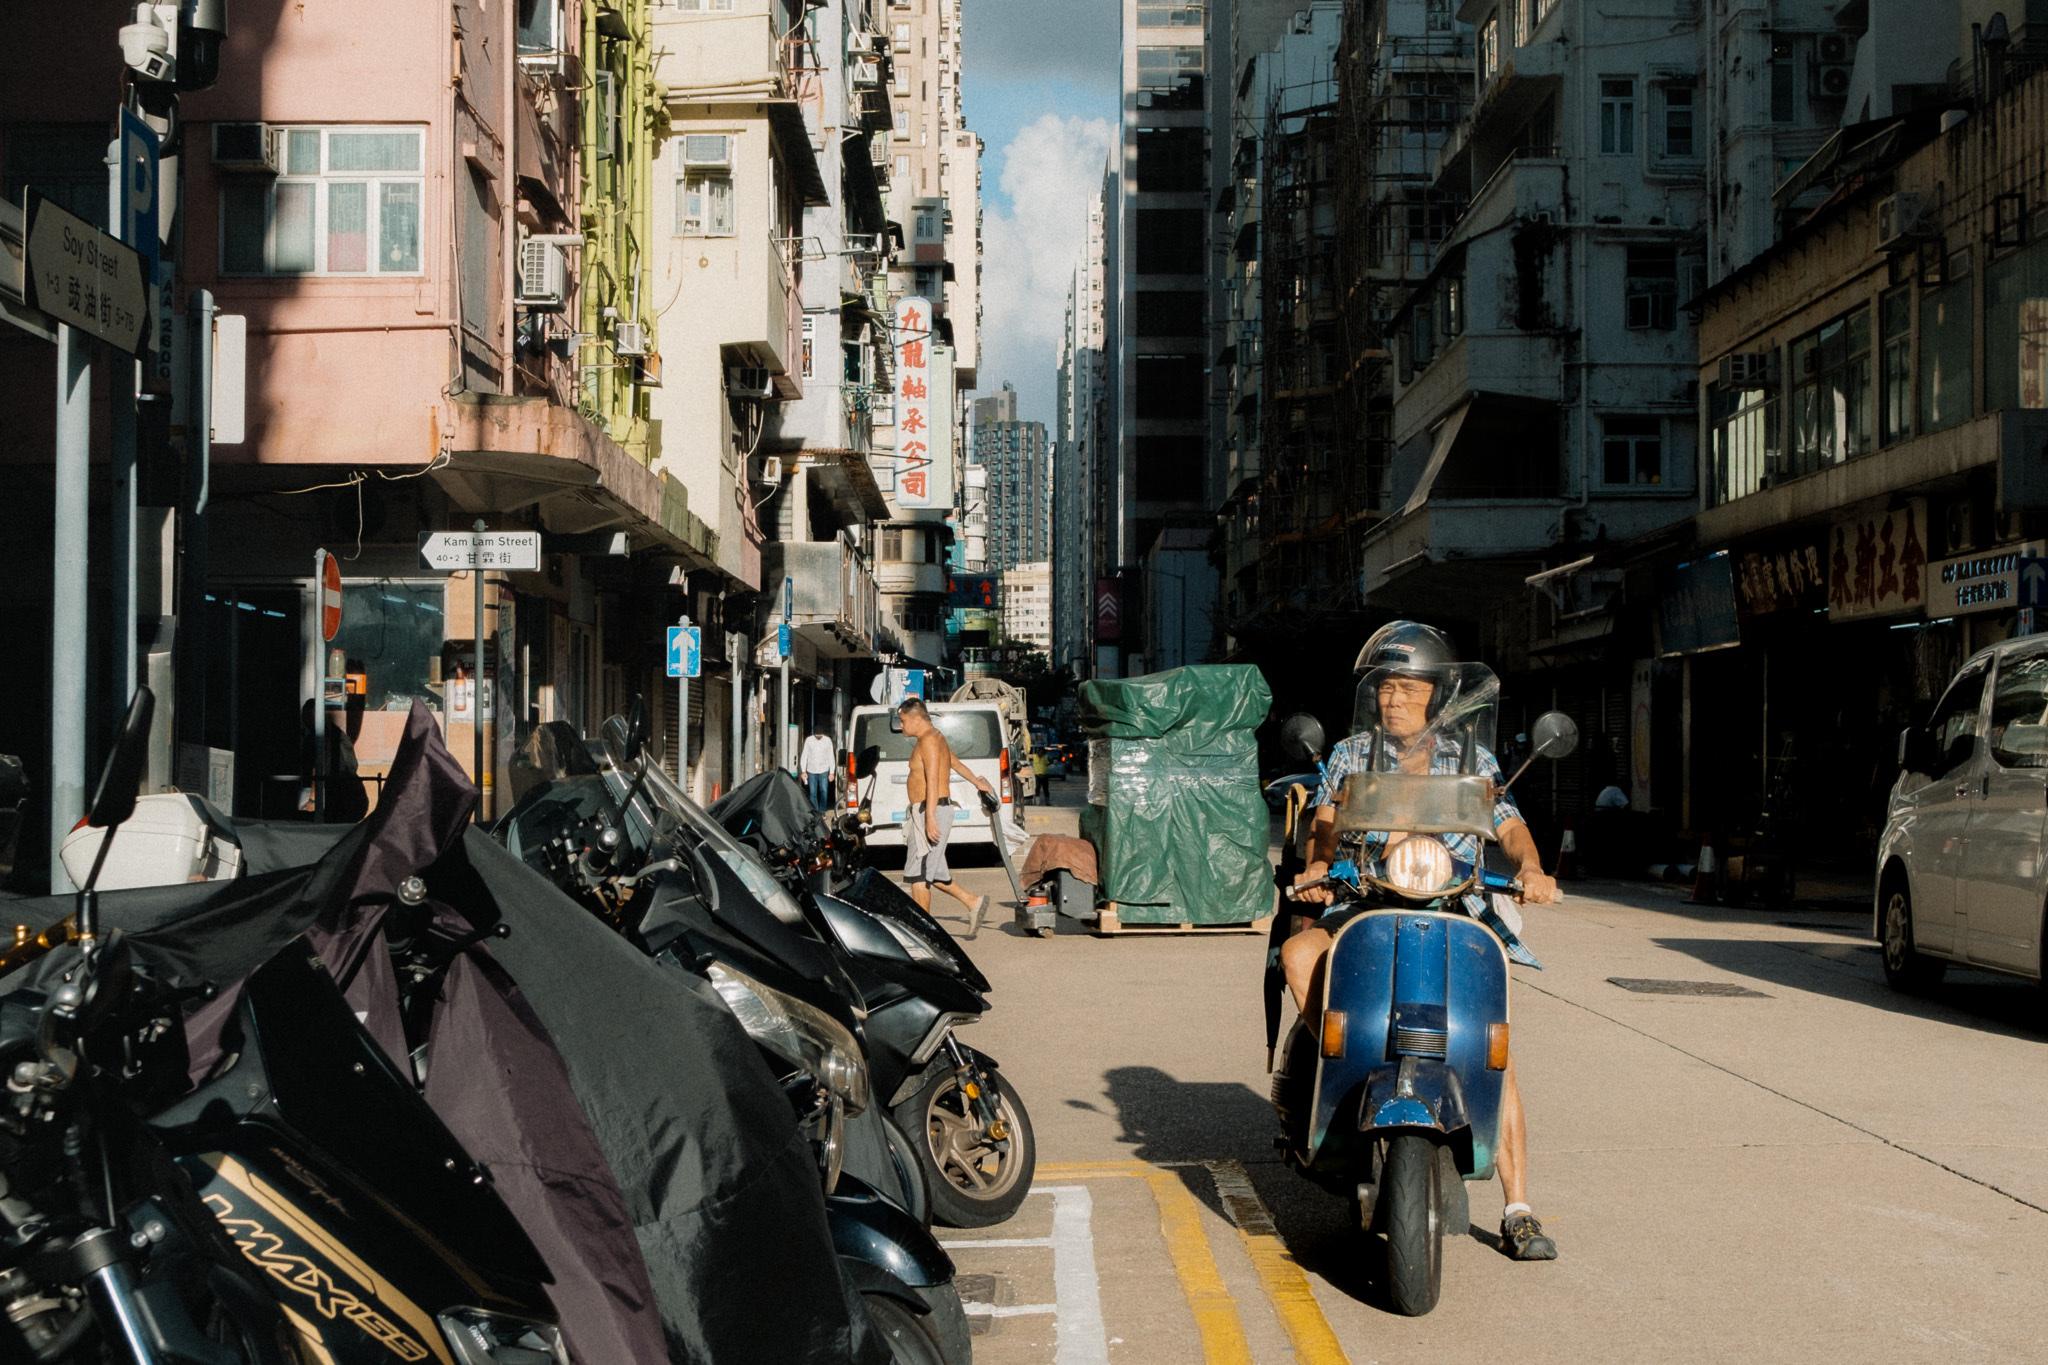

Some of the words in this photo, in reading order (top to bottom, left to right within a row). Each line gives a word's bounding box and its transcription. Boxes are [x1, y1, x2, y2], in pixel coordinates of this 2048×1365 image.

[63, 226, 84, 265] Soy
[45, 271, 60, 294] 1-3
[68, 276, 112, 327] 豉油街
[163, 280, 173, 309] AA
[901, 306, 927, 499] 九龍軸承公司
[444, 537, 468, 546] Kam
[473, 537, 494, 546] Lam
[498, 537, 533, 546] Street
[467, 552, 511, 564] 甘霖街
